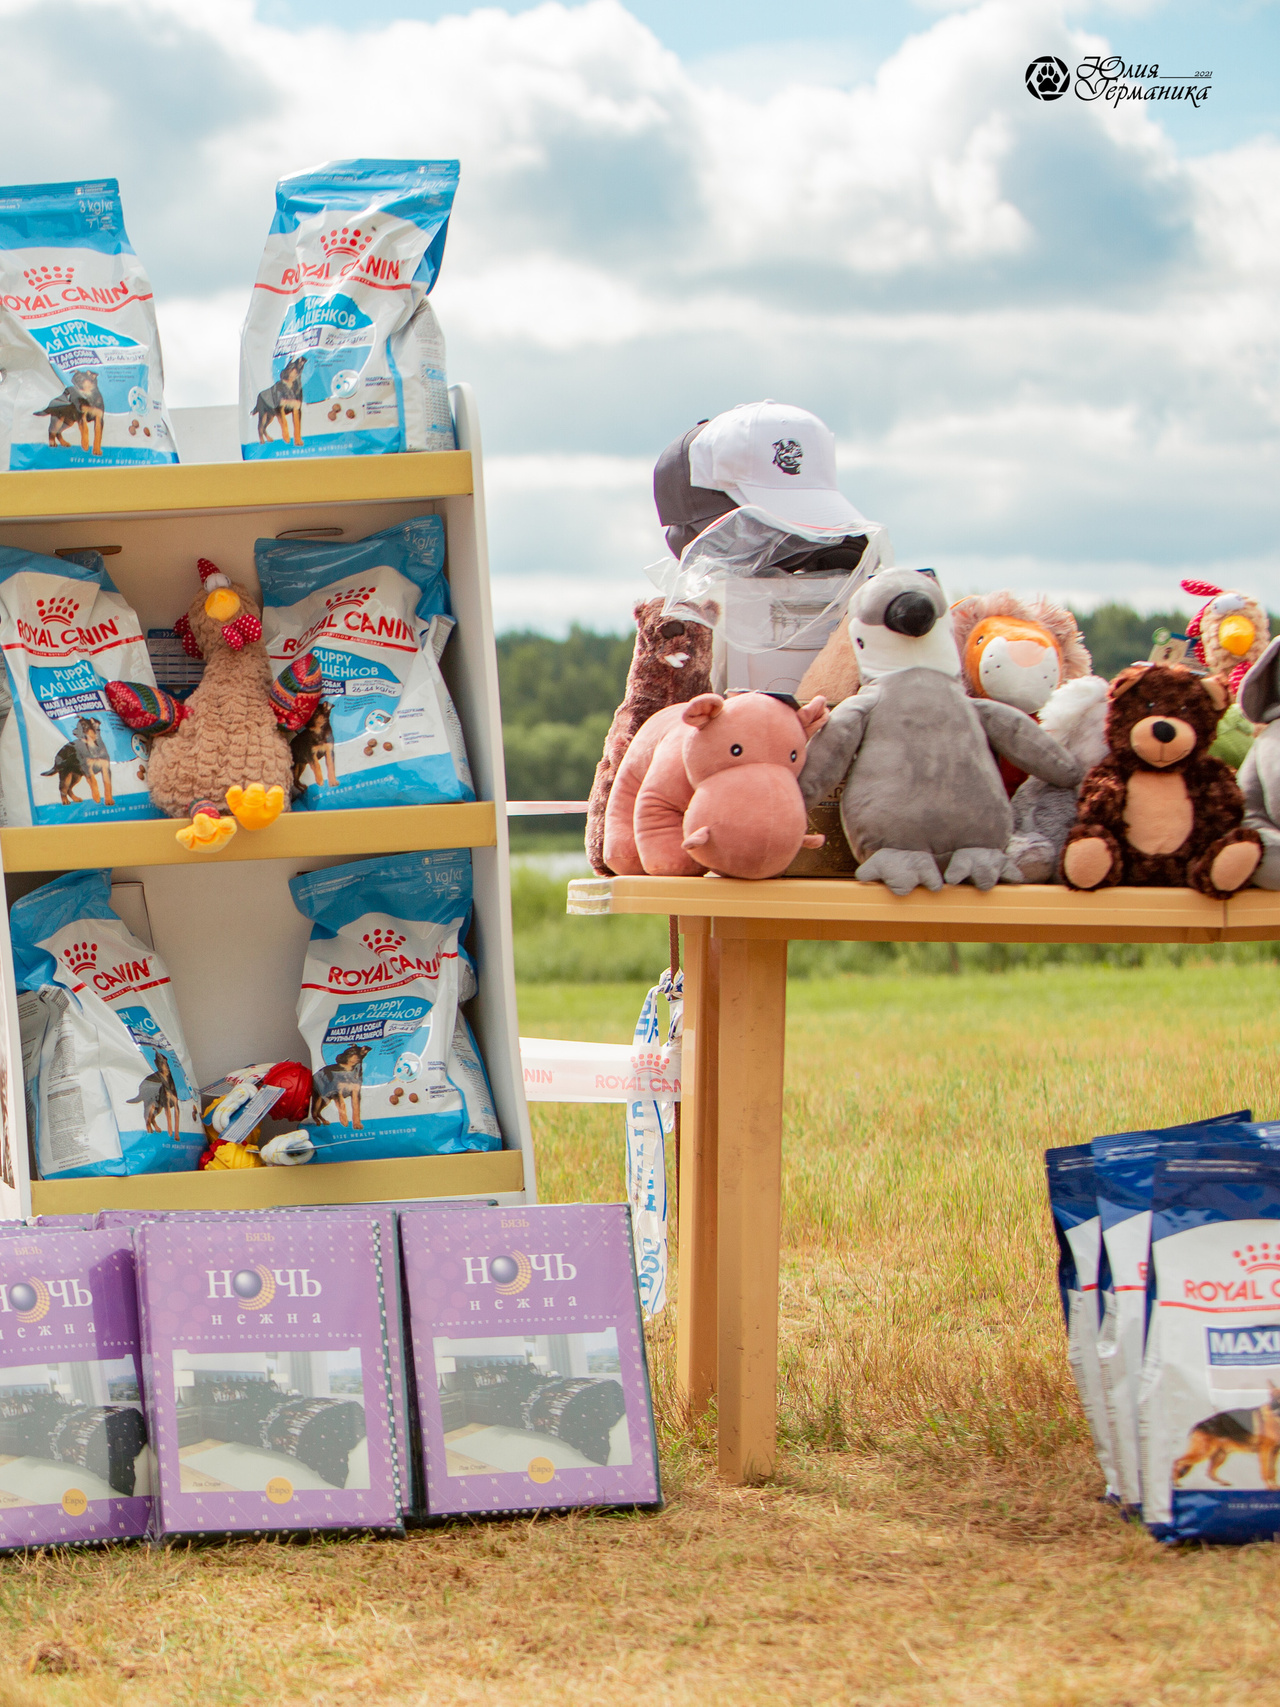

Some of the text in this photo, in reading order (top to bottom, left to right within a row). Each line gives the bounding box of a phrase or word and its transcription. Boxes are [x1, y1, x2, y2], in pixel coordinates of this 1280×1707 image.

[79, 199, 86, 213] 3
[4, 280, 129, 311] OYAL CANIN
[305, 308, 356, 327] ЩЕНКОВ
[51, 321, 89, 337] PUPPY
[64, 334, 120, 348] ЩЕНКОВ
[17, 619, 60, 648] ROYAL
[283, 611, 415, 653] ROYAL CANIN
[53, 662, 92, 681] PUPPY
[320, 662, 379, 678] ЩЕНКОВ
[40, 680, 67, 699] ДЛЯ
[424, 868, 464, 885] 3 kg/кг
[328, 961, 393, 987] ROYAL
[366, 999, 405, 1013] PUPPY
[335, 1007, 422, 1025] ДЛЯ ЩЕНКОВ
[331, 1027, 347, 1036] MAXI
[524, 1068, 682, 1093] NIN ROYAL CAN
[379, 1128, 417, 1136] NUTRITION
[462, 1252, 577, 1286] НОЧЬ
[205, 1267, 322, 1301] НОЧЬ
[1183, 1279, 1264, 1301] ROYAL
[470, 1296, 578, 1312] нежна
[211, 1312, 322, 1325] нежна
[1209, 1331, 1280, 1353] MAXI
